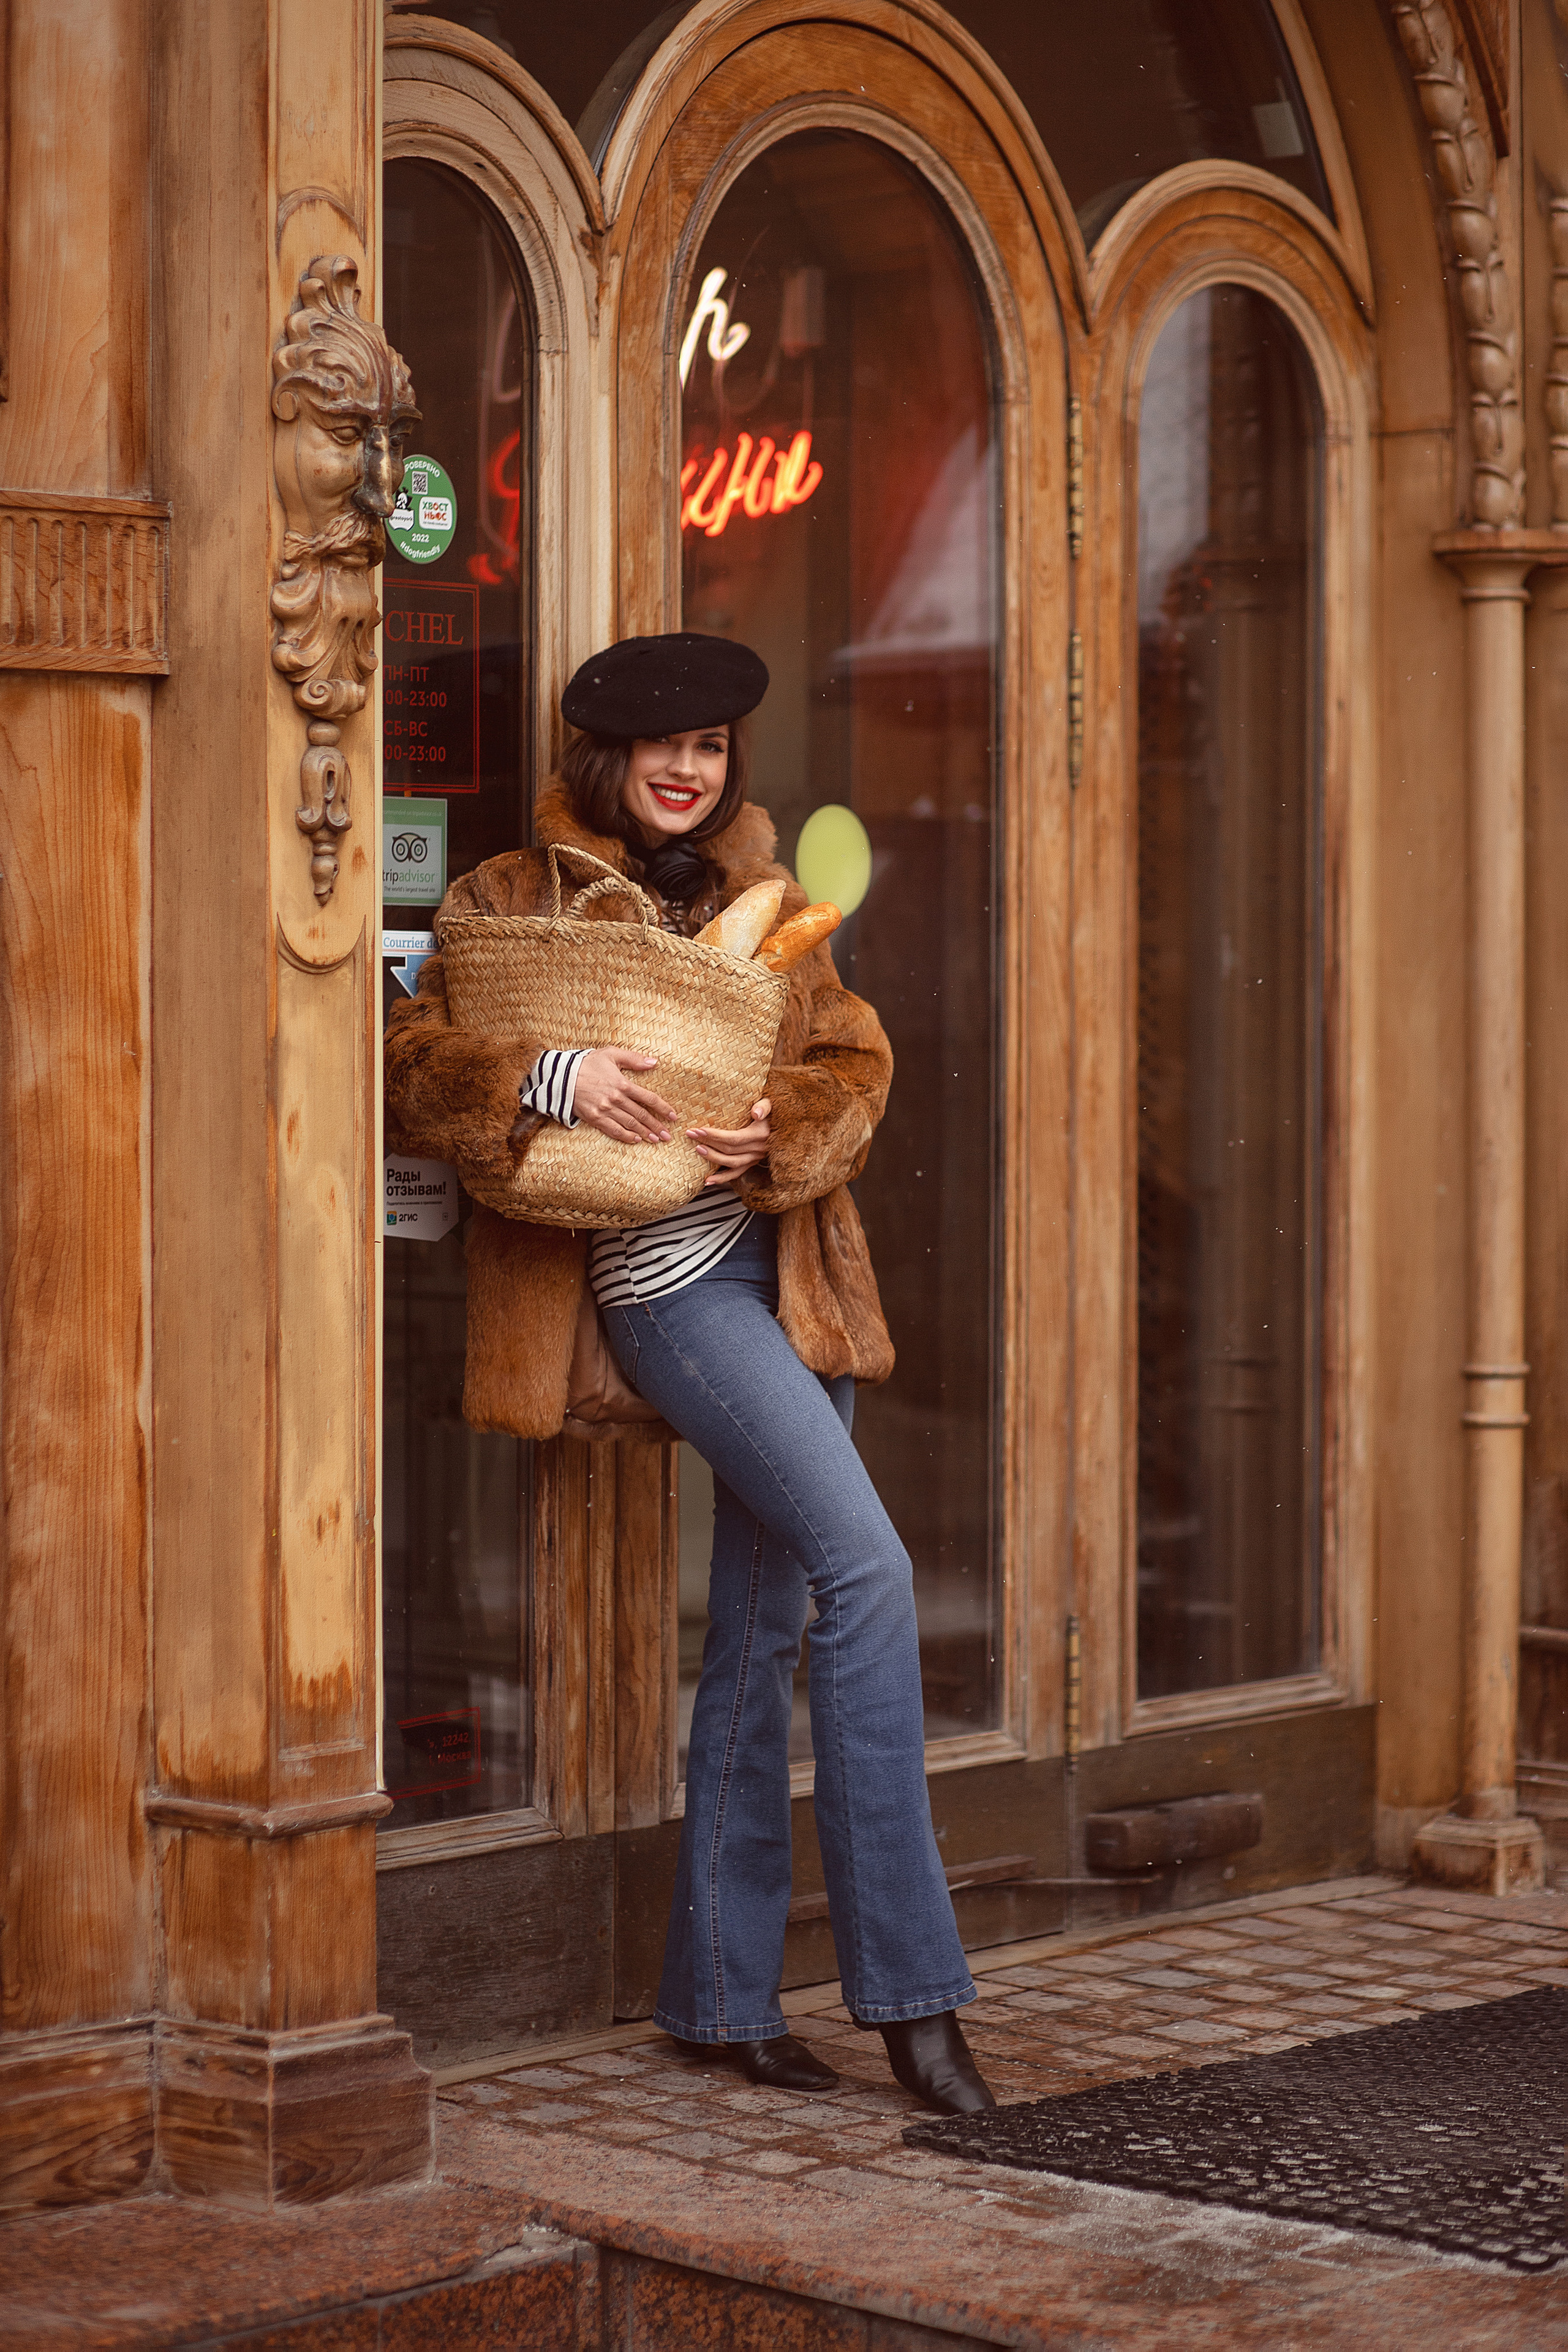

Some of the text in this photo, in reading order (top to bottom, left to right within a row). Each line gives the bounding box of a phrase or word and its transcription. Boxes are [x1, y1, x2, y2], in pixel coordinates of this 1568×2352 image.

[404, 461, 440, 478] РОВЕРЕНО
[422, 501, 449, 512] ХВОСТ
[412, 533, 430, 543] 2022
[400, 541, 440, 559] #dogfriendly
[383, 665, 429, 682] ПН-ПТ
[383, 720, 428, 737] СБ-ВС
[382, 869, 435, 884] tripadvisor
[383, 937, 425, 948] Courrier
[386, 1169, 421, 1184] Рады
[386, 1182, 447, 1196] отзывам!
[399, 1213, 418, 1222] 2ГИС
[437, 1751, 472, 1765] Москва
